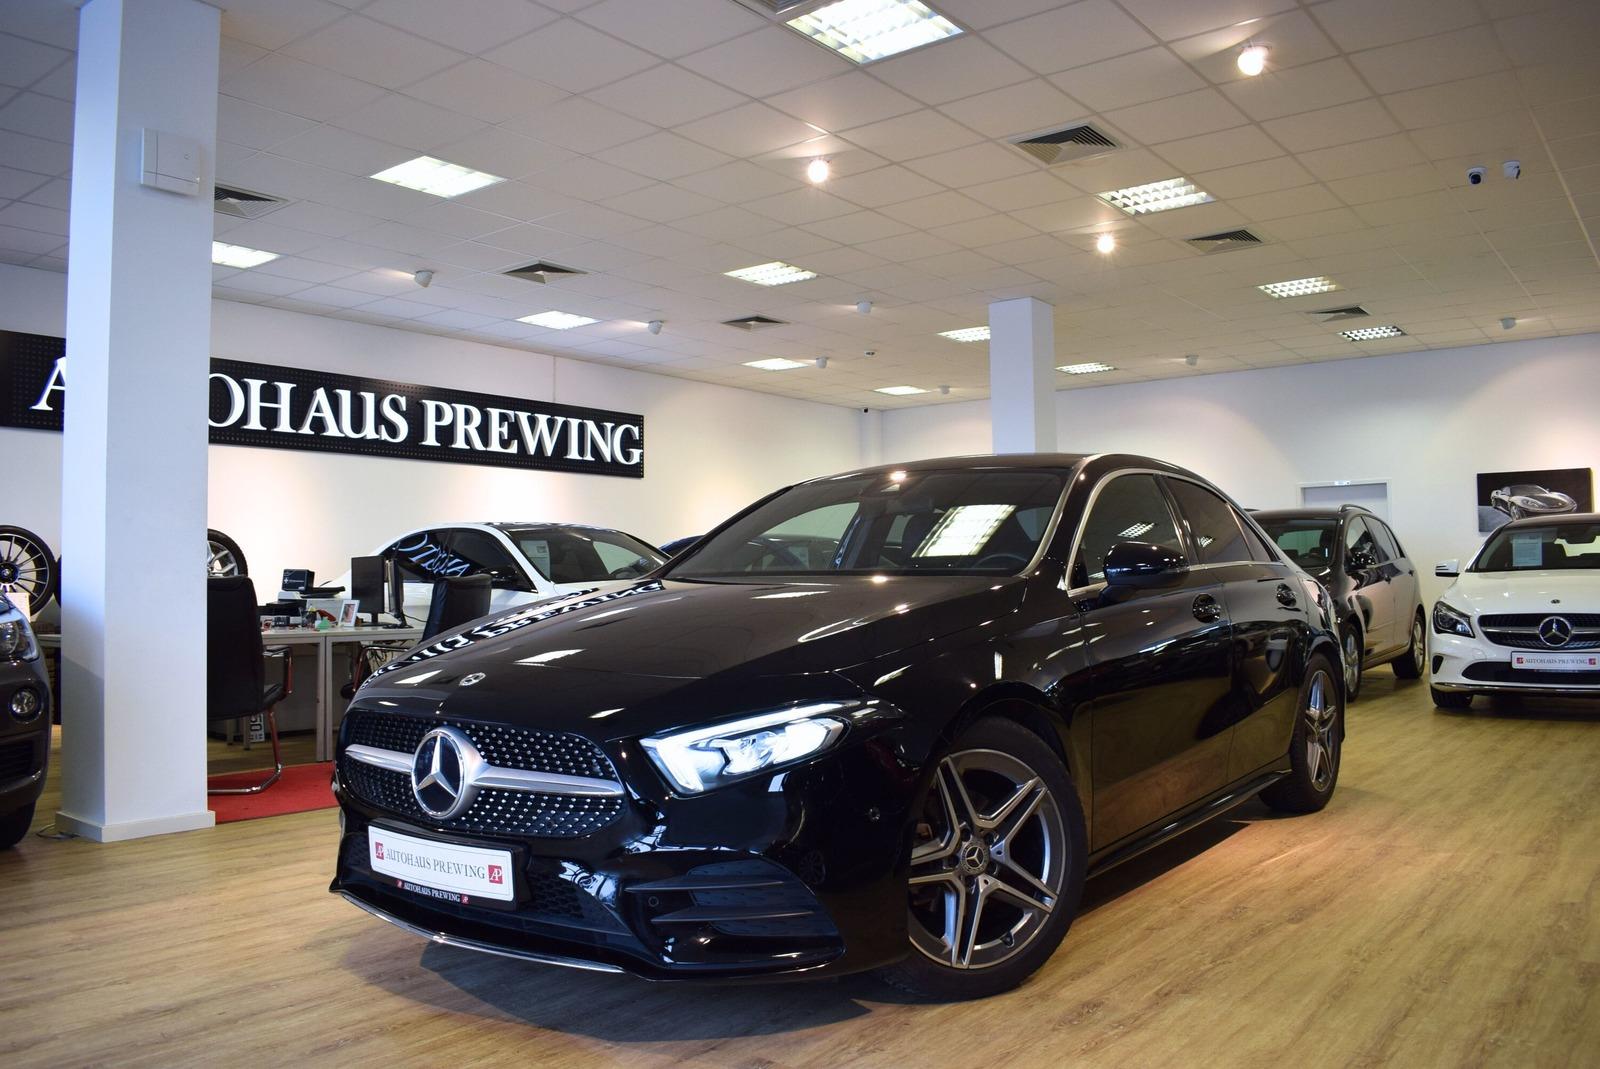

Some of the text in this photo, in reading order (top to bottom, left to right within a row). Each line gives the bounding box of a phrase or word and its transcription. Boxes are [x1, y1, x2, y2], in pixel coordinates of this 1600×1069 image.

[30, 356, 644, 465] AOHAUS PREWING
[386, 848, 432, 869] AUTOHAUS
[433, 859, 486, 879] PREWING
[404, 882, 431, 896] AUTOHAUS
[431, 889, 460, 903] PREWING
